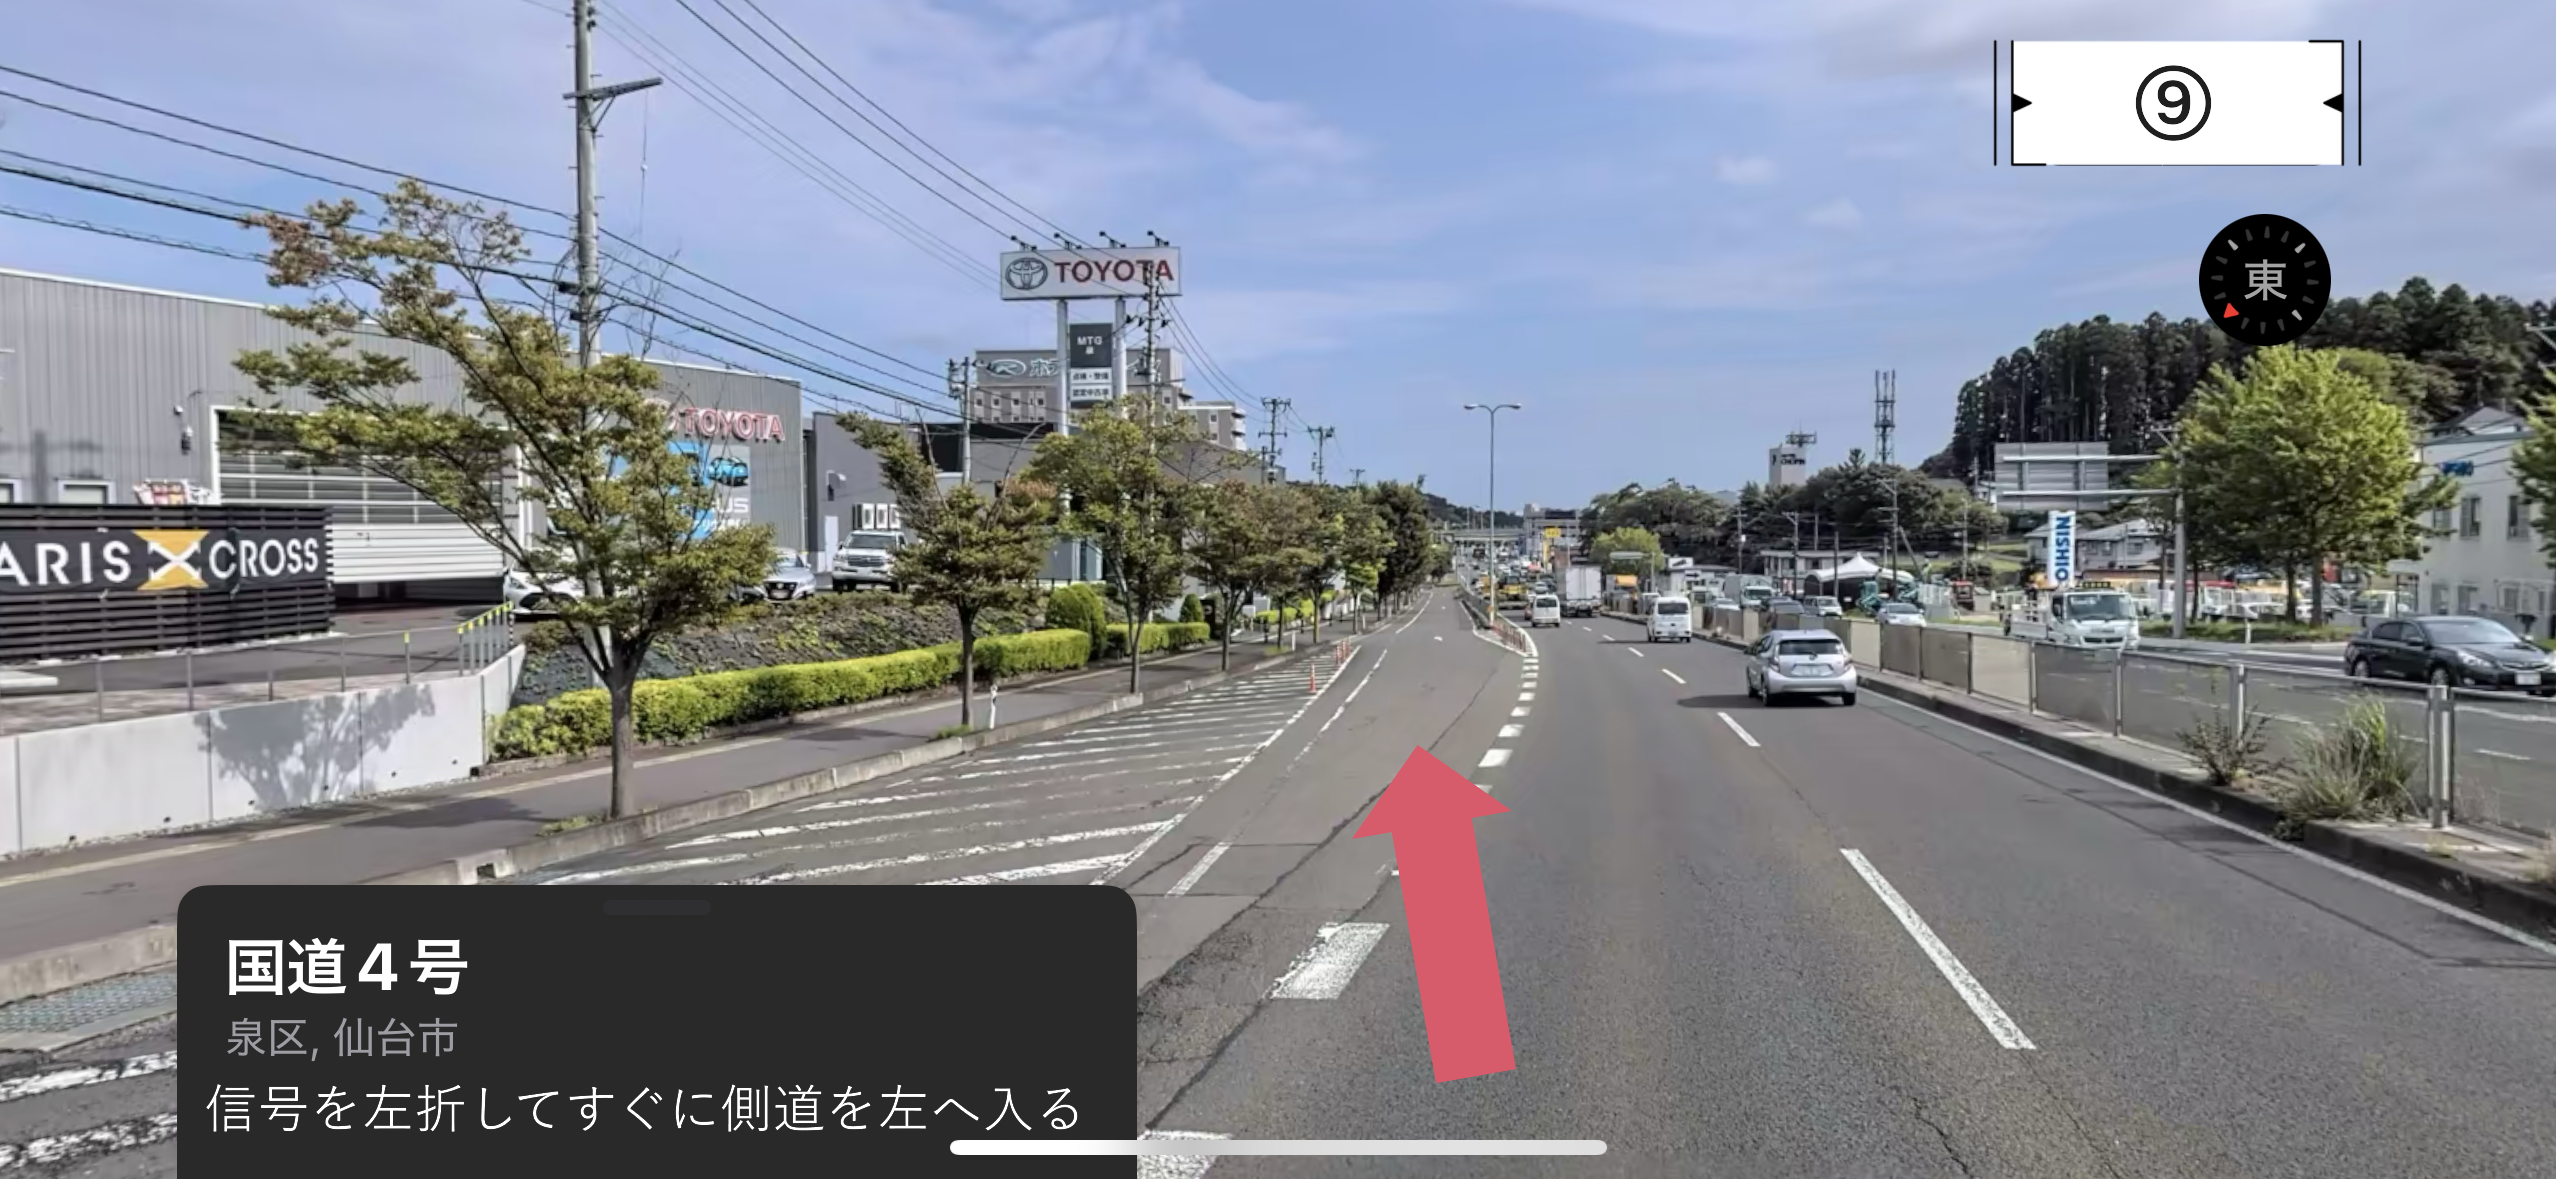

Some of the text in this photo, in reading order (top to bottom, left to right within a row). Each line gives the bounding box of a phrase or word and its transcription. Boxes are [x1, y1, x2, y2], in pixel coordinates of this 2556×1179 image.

[1054, 260, 1174, 283] TOYOTA
[1077, 336, 1103, 346] MTG
[683, 407, 785, 442] TOYOTA
[208, 537, 319, 580] CROSS
[2055, 516, 2070, 581] NISHIO
